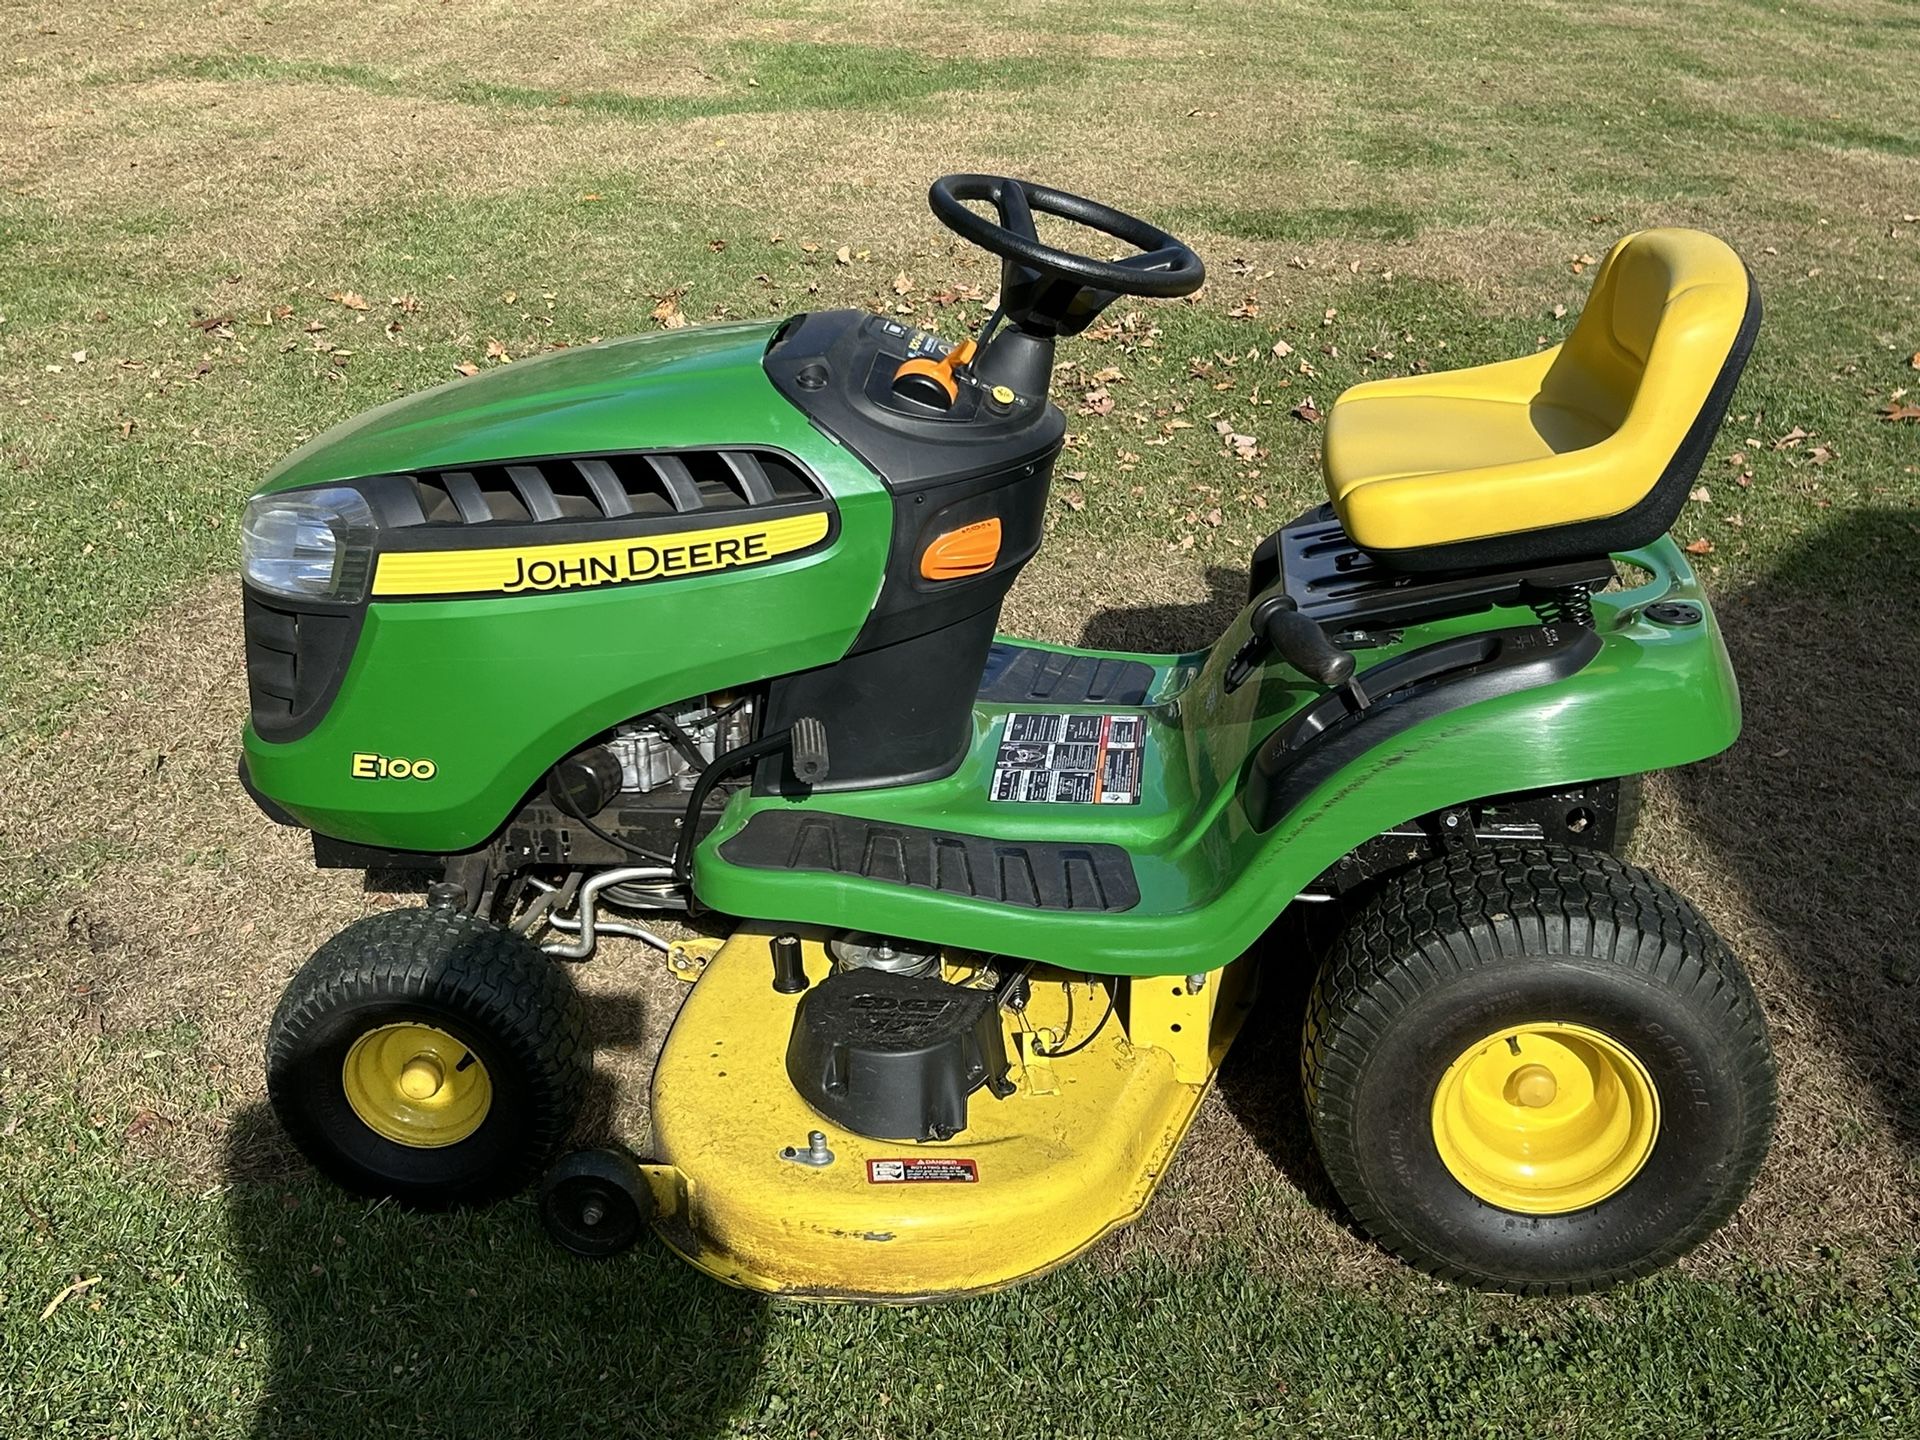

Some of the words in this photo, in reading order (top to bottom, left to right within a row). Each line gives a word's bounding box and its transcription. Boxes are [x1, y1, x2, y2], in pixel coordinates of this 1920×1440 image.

[503, 555, 618, 588] JOHN
[629, 533, 768, 576] DEERE
[351, 752, 437, 780] E100
